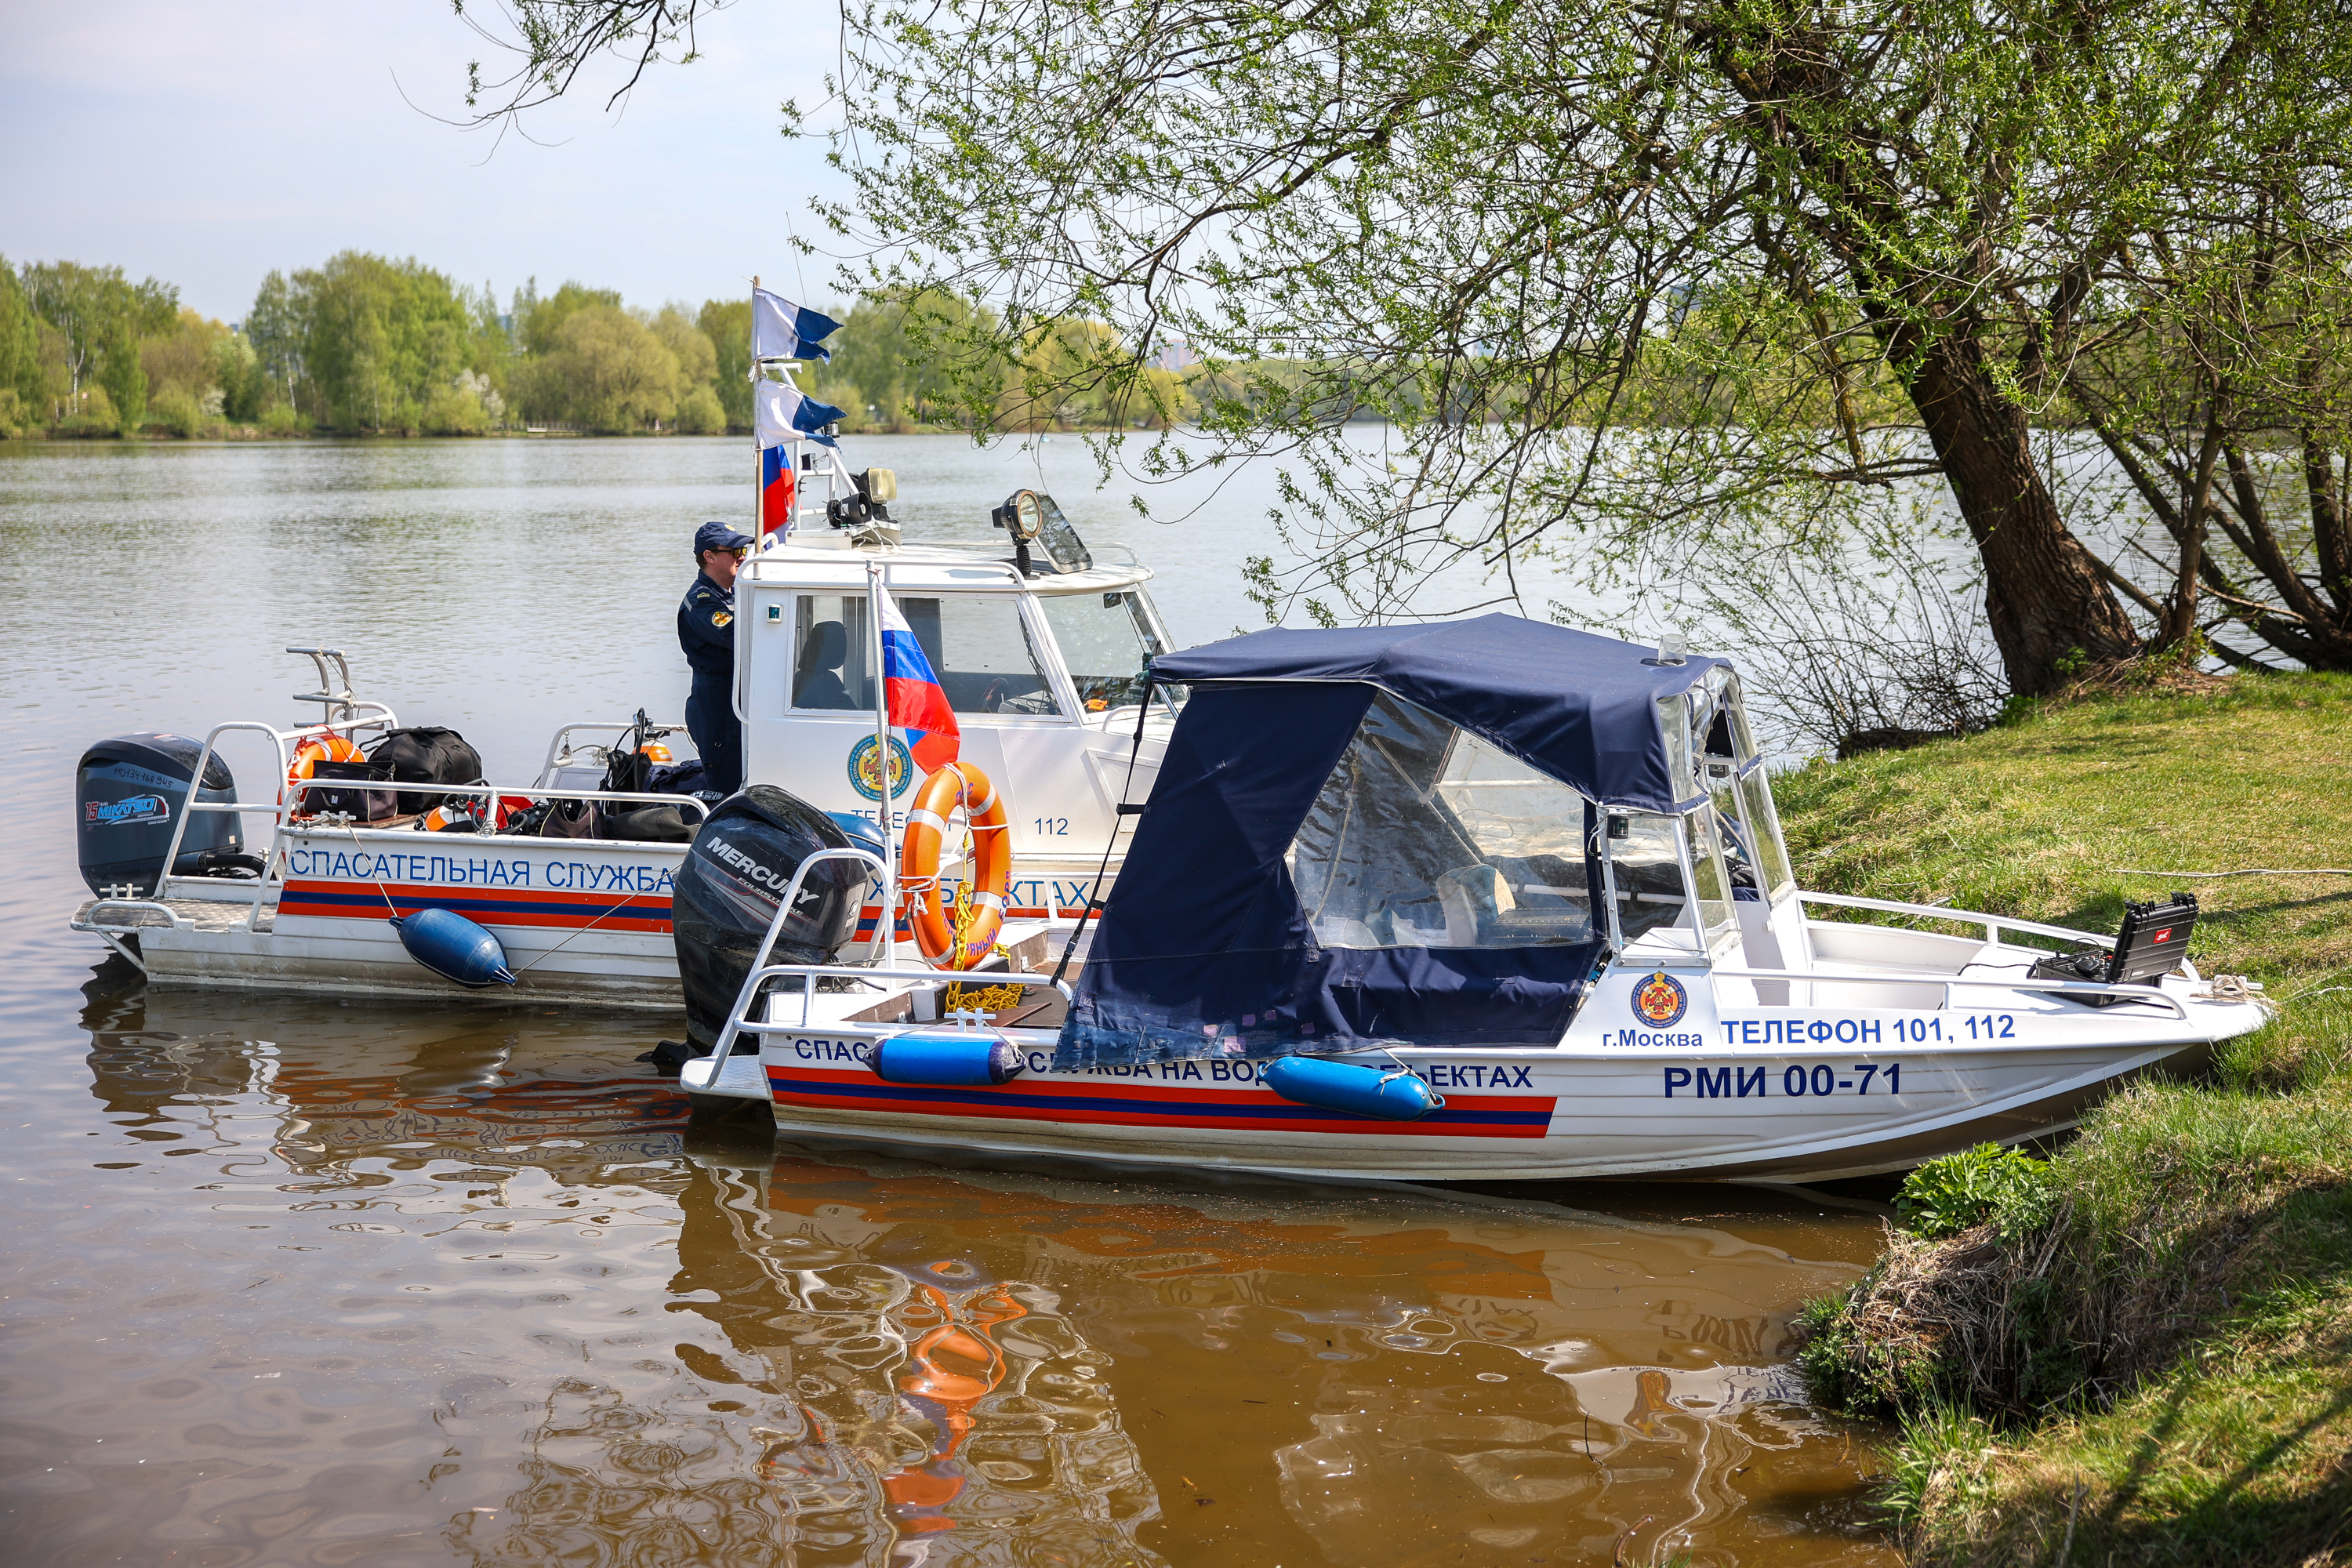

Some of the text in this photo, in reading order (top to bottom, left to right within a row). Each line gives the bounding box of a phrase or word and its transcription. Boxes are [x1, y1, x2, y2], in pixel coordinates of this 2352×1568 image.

[1034, 818, 1069, 835] 112
[291, 849, 530, 886] СПАСАТЕЛЬНАЯ
[545, 861, 676, 893] СЛУЖБА
[1602, 1029, 1704, 1047] г.Москва
[1720, 1014, 2016, 1044] ТЕЛЕФОН 101, 112
[1162, 1061, 1203, 1081] НА
[1664, 1063, 1900, 1098] РМИ 00-71
